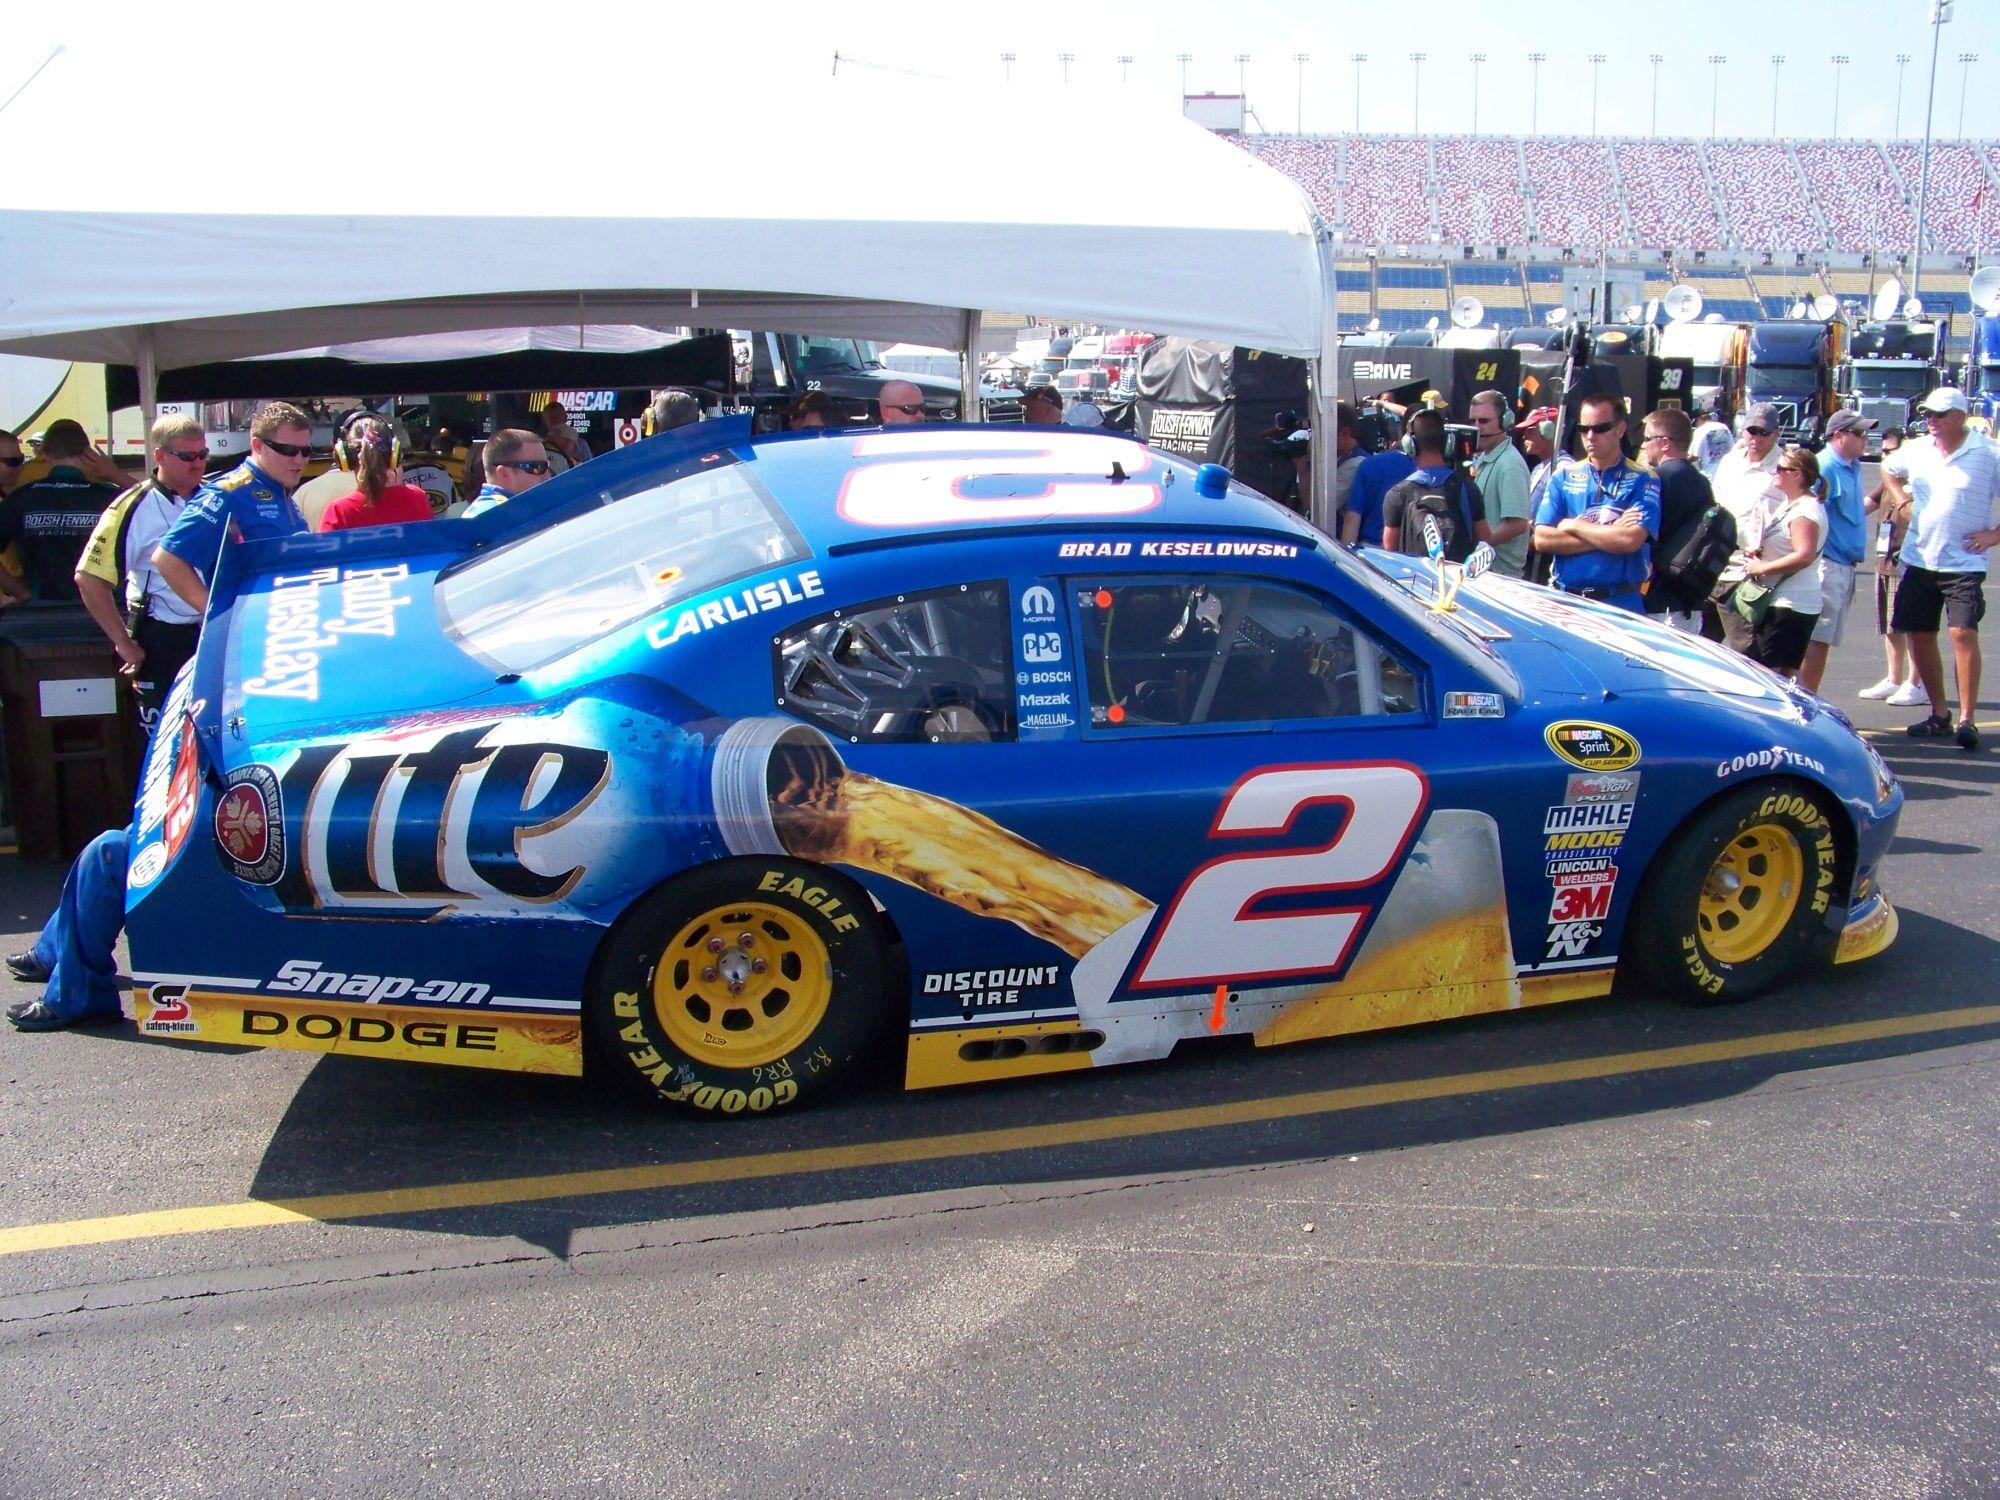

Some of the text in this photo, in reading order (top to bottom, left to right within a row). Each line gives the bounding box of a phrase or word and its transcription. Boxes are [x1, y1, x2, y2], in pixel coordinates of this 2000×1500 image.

[1353, 360, 1412, 380] DRIVE
[1475, 362, 1498, 381] 24
[1660, 368, 1682, 389] 39
[807, 381, 821, 391] 22
[557, 391, 615, 412] NASCAR
[1150, 410, 1181, 438] ROUSH
[216, 439, 228, 448] 10
[1161, 439, 1195, 453] RACING
[1058, 542, 1298, 558] BRAD KESELOWSKI
[323, 563, 412, 636] Ruby
[645, 570, 825, 650] CARLISLE
[241, 567, 339, 701] Tuesday
[1024, 633, 1061, 657] PPG
[1032, 671, 1071, 683] BOSCH
[1020, 692, 1071, 707] Mazak
[1468, 695, 1495, 706] NASCAR
[1027, 712, 1067, 726] MAGELLAN
[1448, 707, 1500, 715] RACE CAR
[1572, 730, 1602, 741] NASCAR
[1579, 741, 1611, 755] Sprint
[1600, 781, 1634, 793] LIGHT
[1576, 794, 1622, 803] POLE
[1547, 803, 1633, 828] MAHLE
[1544, 830, 1626, 851] MOOG
[1545, 849, 1585, 860] CHASSIS
[1130, 759, 1431, 991] 2
[1550, 859, 1608, 874] LINCOLN
[1560, 872, 1610, 885] WELDERS
[757, 871, 860, 933] EAGLE
[1552, 885, 1612, 921] 3M
[1682, 934, 1726, 994] EAGLE
[266, 959, 491, 1005] Snap-on
[923, 965, 1059, 993] DISCOUNT
[959, 989, 1019, 1007] TIRE
[145, 1021, 195, 1032] safety-kleen
[242, 1009, 499, 1051] DODGE
